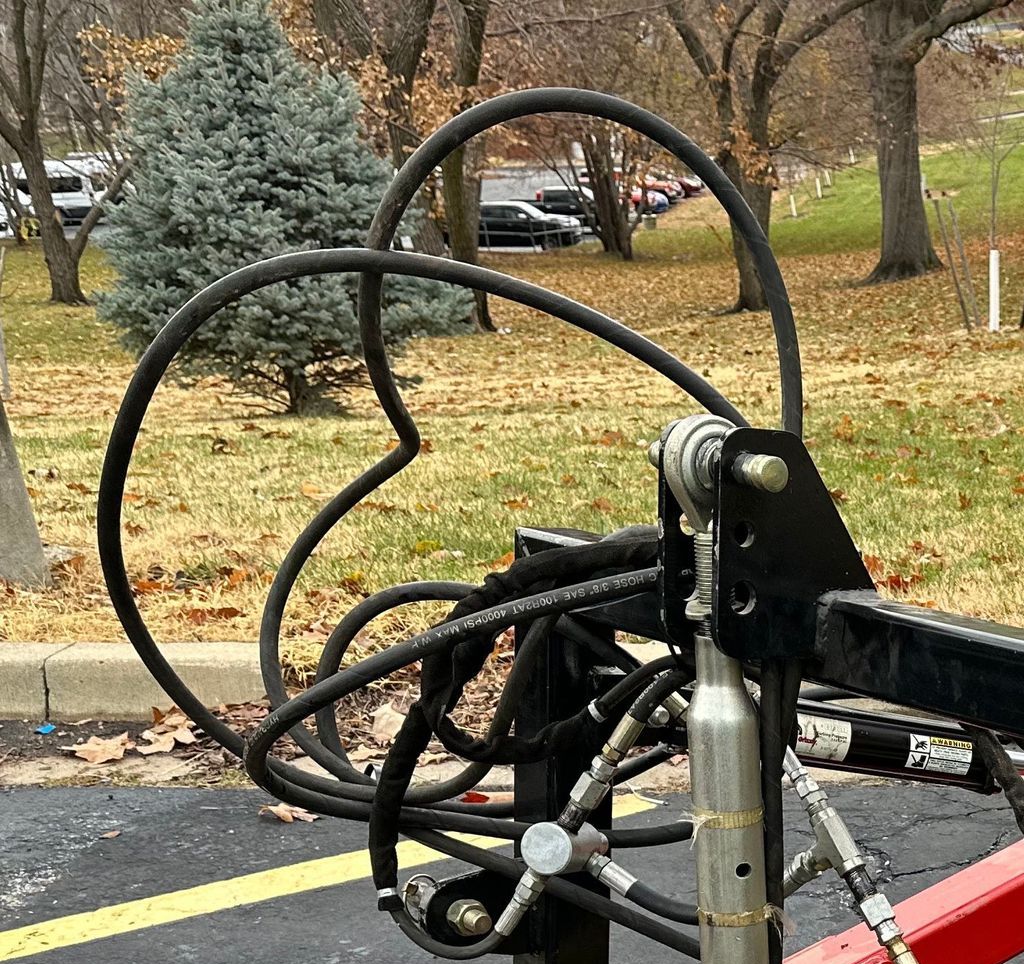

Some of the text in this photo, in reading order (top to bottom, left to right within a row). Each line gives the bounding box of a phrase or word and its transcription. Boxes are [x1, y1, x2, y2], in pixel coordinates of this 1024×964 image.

[589, 582, 609, 595] 3/8"
[612, 575, 645, 589] HOSE
[563, 587, 586, 601] SAE
[512, 594, 560, 615] 100R2AT
[464, 609, 507, 629] 4000PSI
[435, 624, 460, 638] MAX
[937, 738, 972, 749] WARNING
